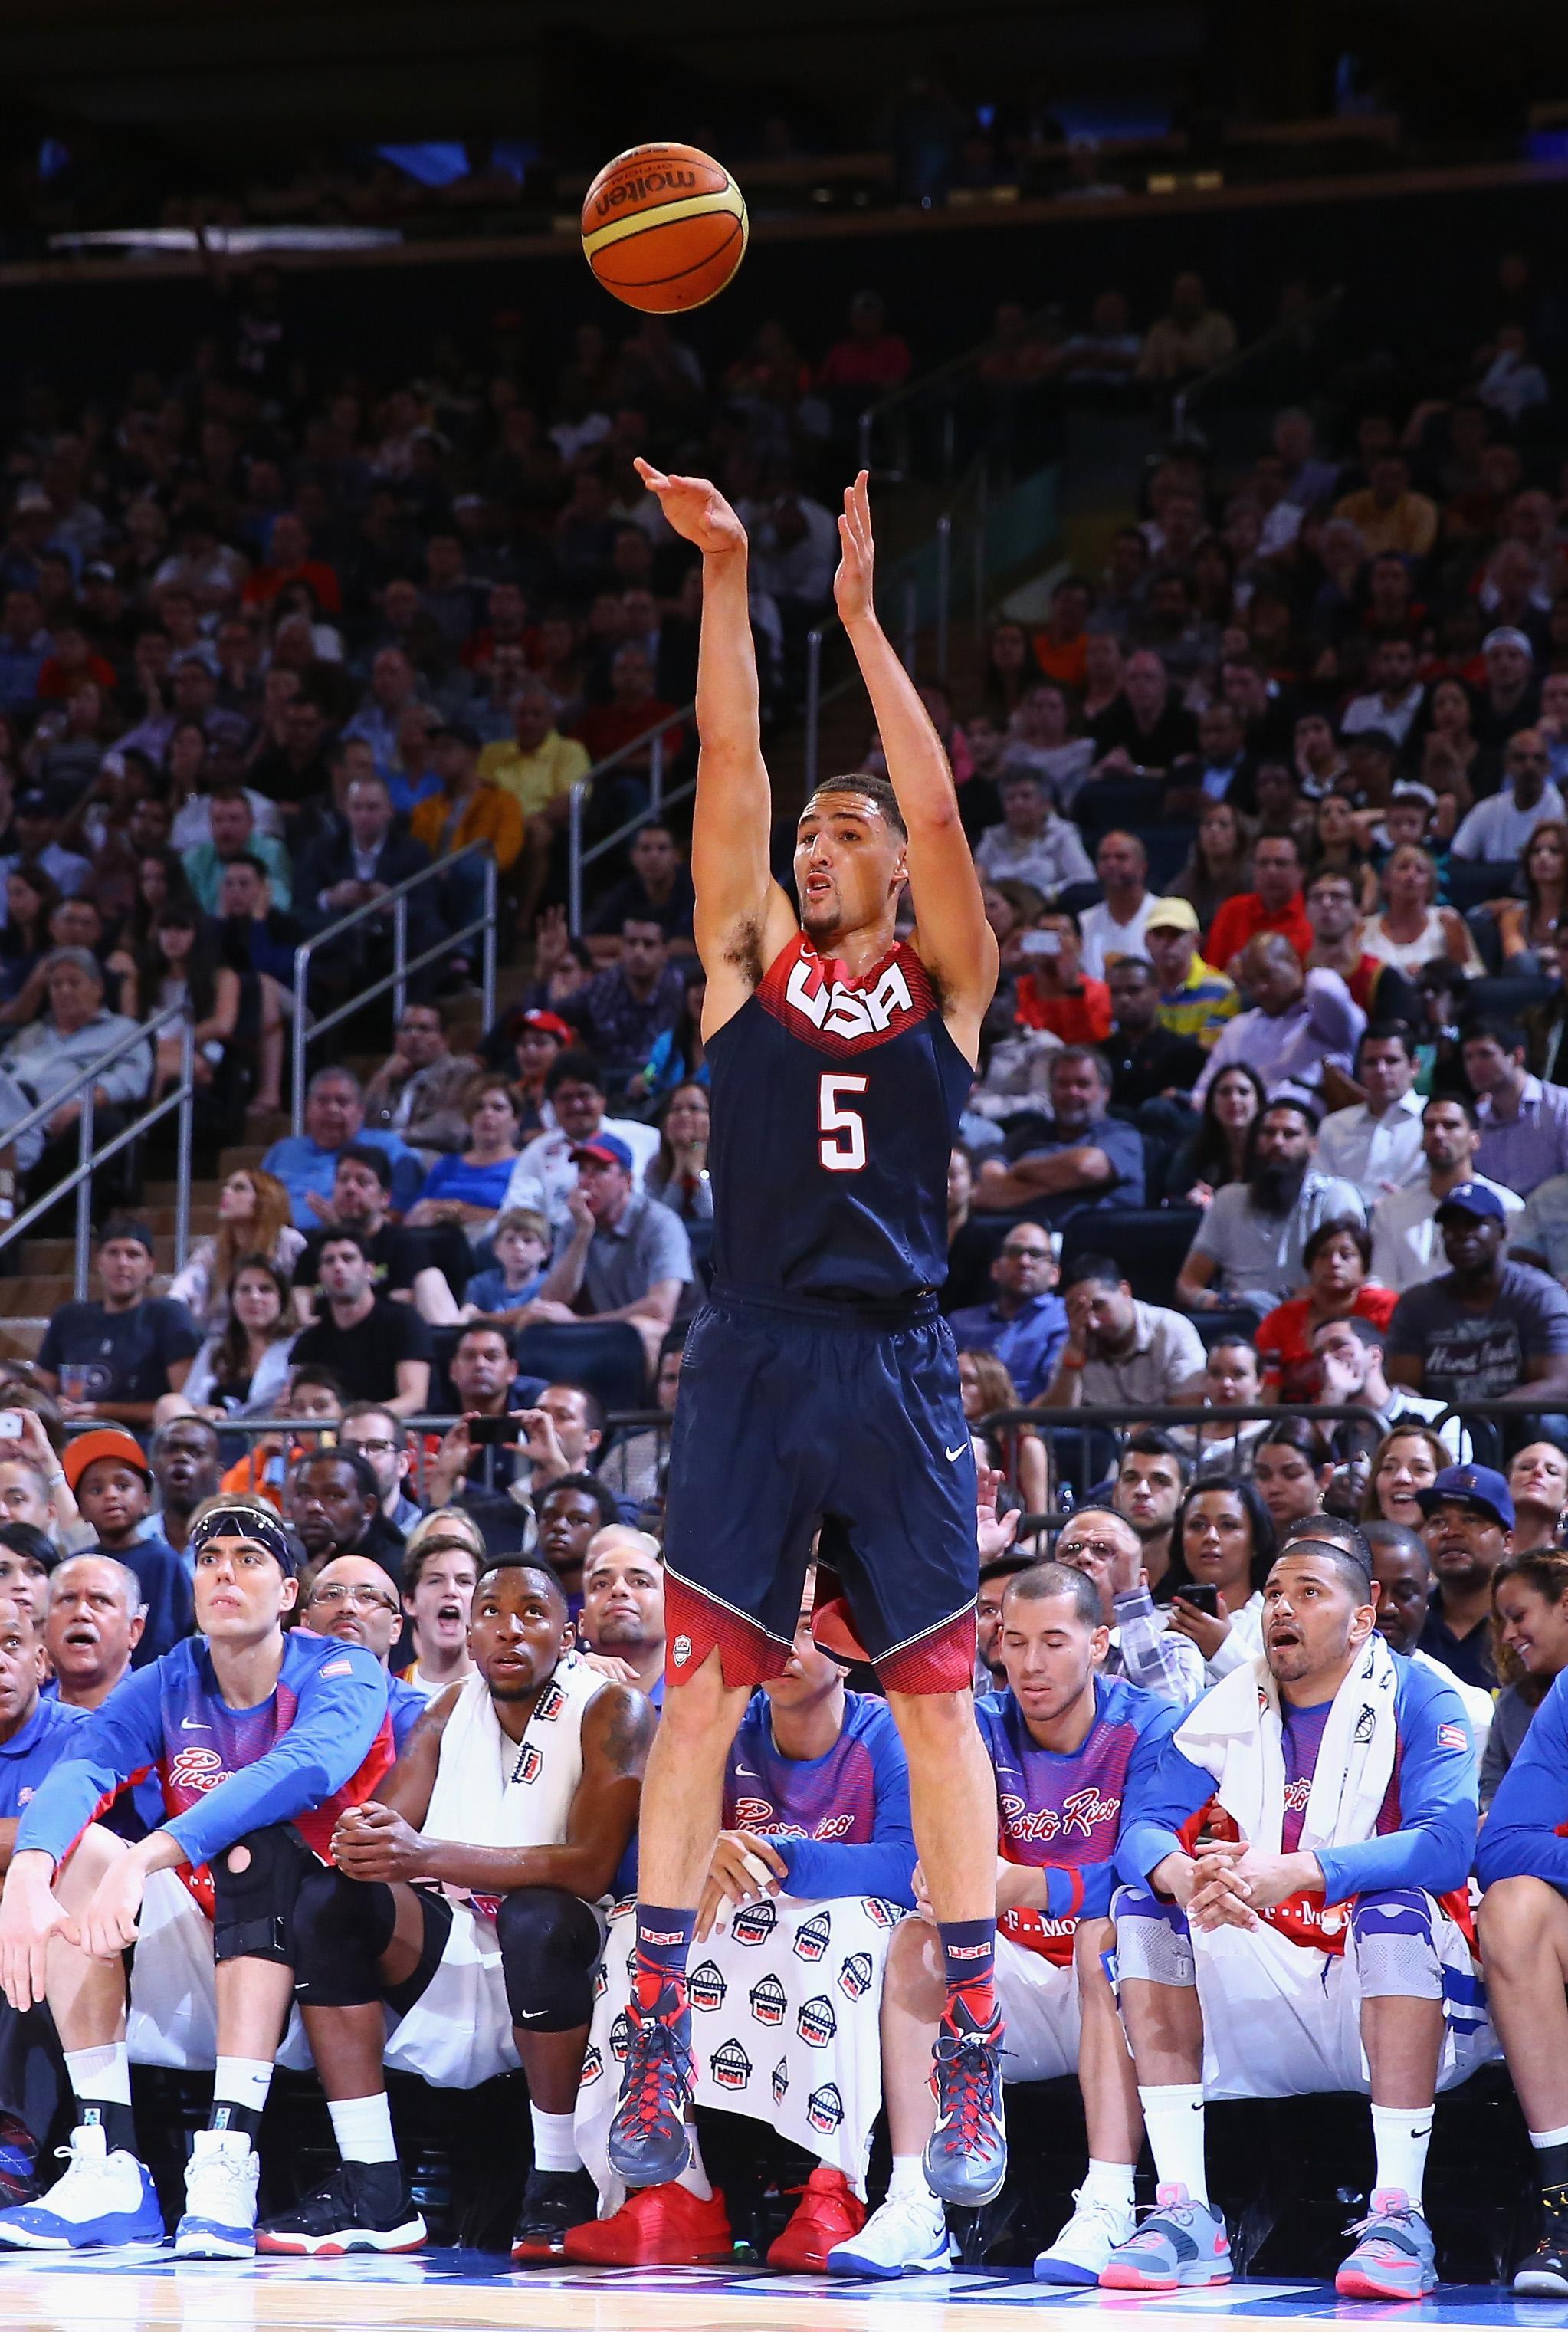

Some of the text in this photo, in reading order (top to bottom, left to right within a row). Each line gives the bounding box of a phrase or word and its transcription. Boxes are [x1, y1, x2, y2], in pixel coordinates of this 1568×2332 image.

[595, 170, 695, 215] molten
[786, 959, 914, 1040] USA
[818, 1072, 868, 1171] 5
[812, 1814, 855, 1841] ico
[1062, 1786, 1121, 1838] Rico
[641, 1927, 684, 1945] USA
[949, 1943, 991, 1959] USA
